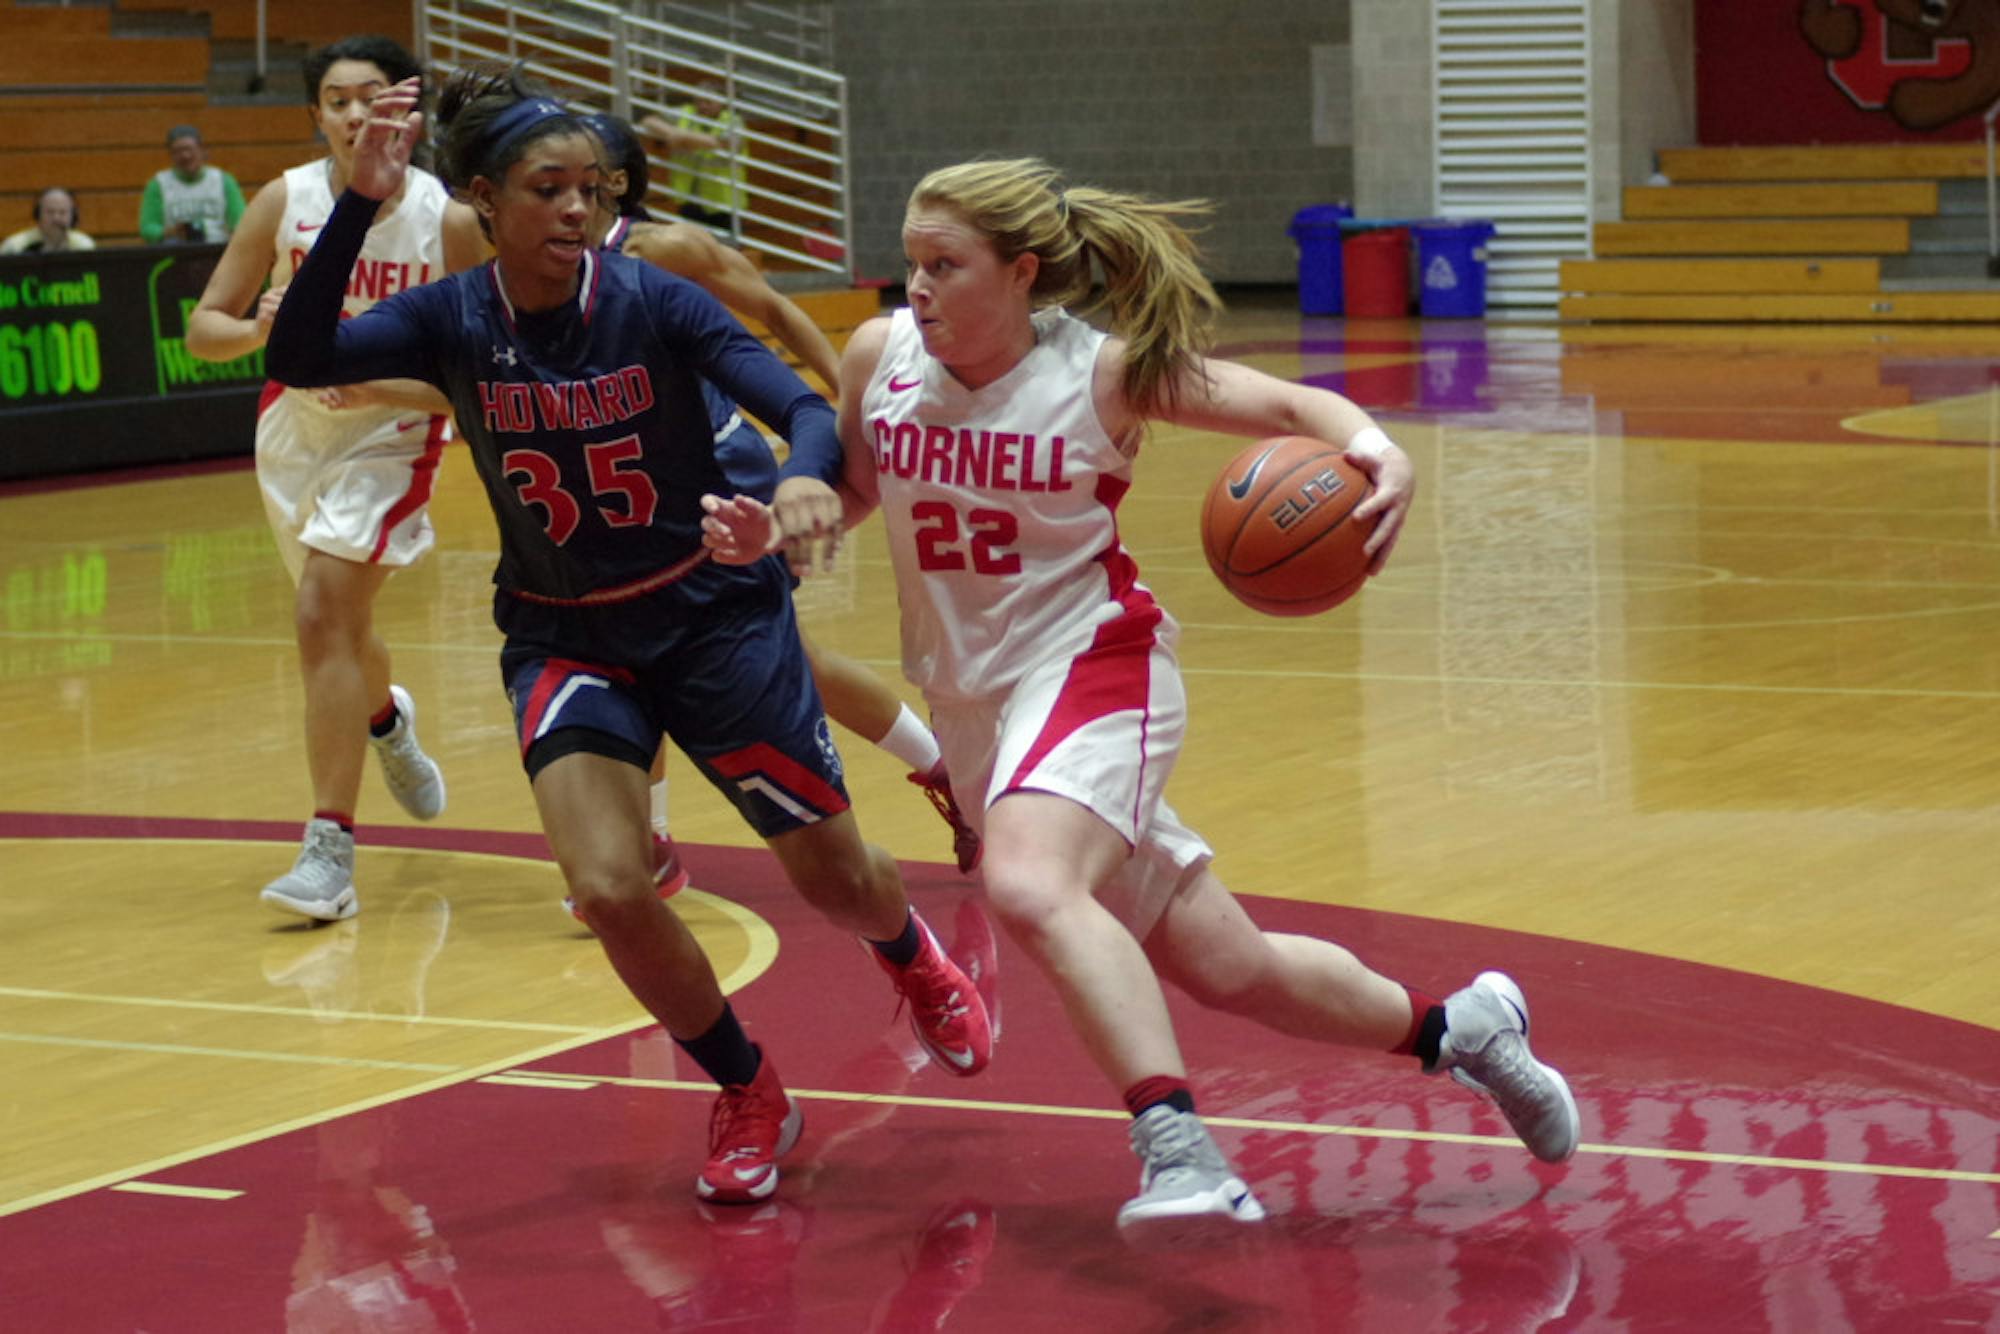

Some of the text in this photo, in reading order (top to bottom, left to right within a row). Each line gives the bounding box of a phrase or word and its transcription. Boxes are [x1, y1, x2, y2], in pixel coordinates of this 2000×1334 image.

[21, 273, 100, 308] Cornell
[0, 321, 101, 398] 6100
[477, 364, 655, 432] HOWARD
[502, 433, 659, 547] 35
[873, 418, 1072, 493] CORNELL
[912, 502, 1022, 575] 22
